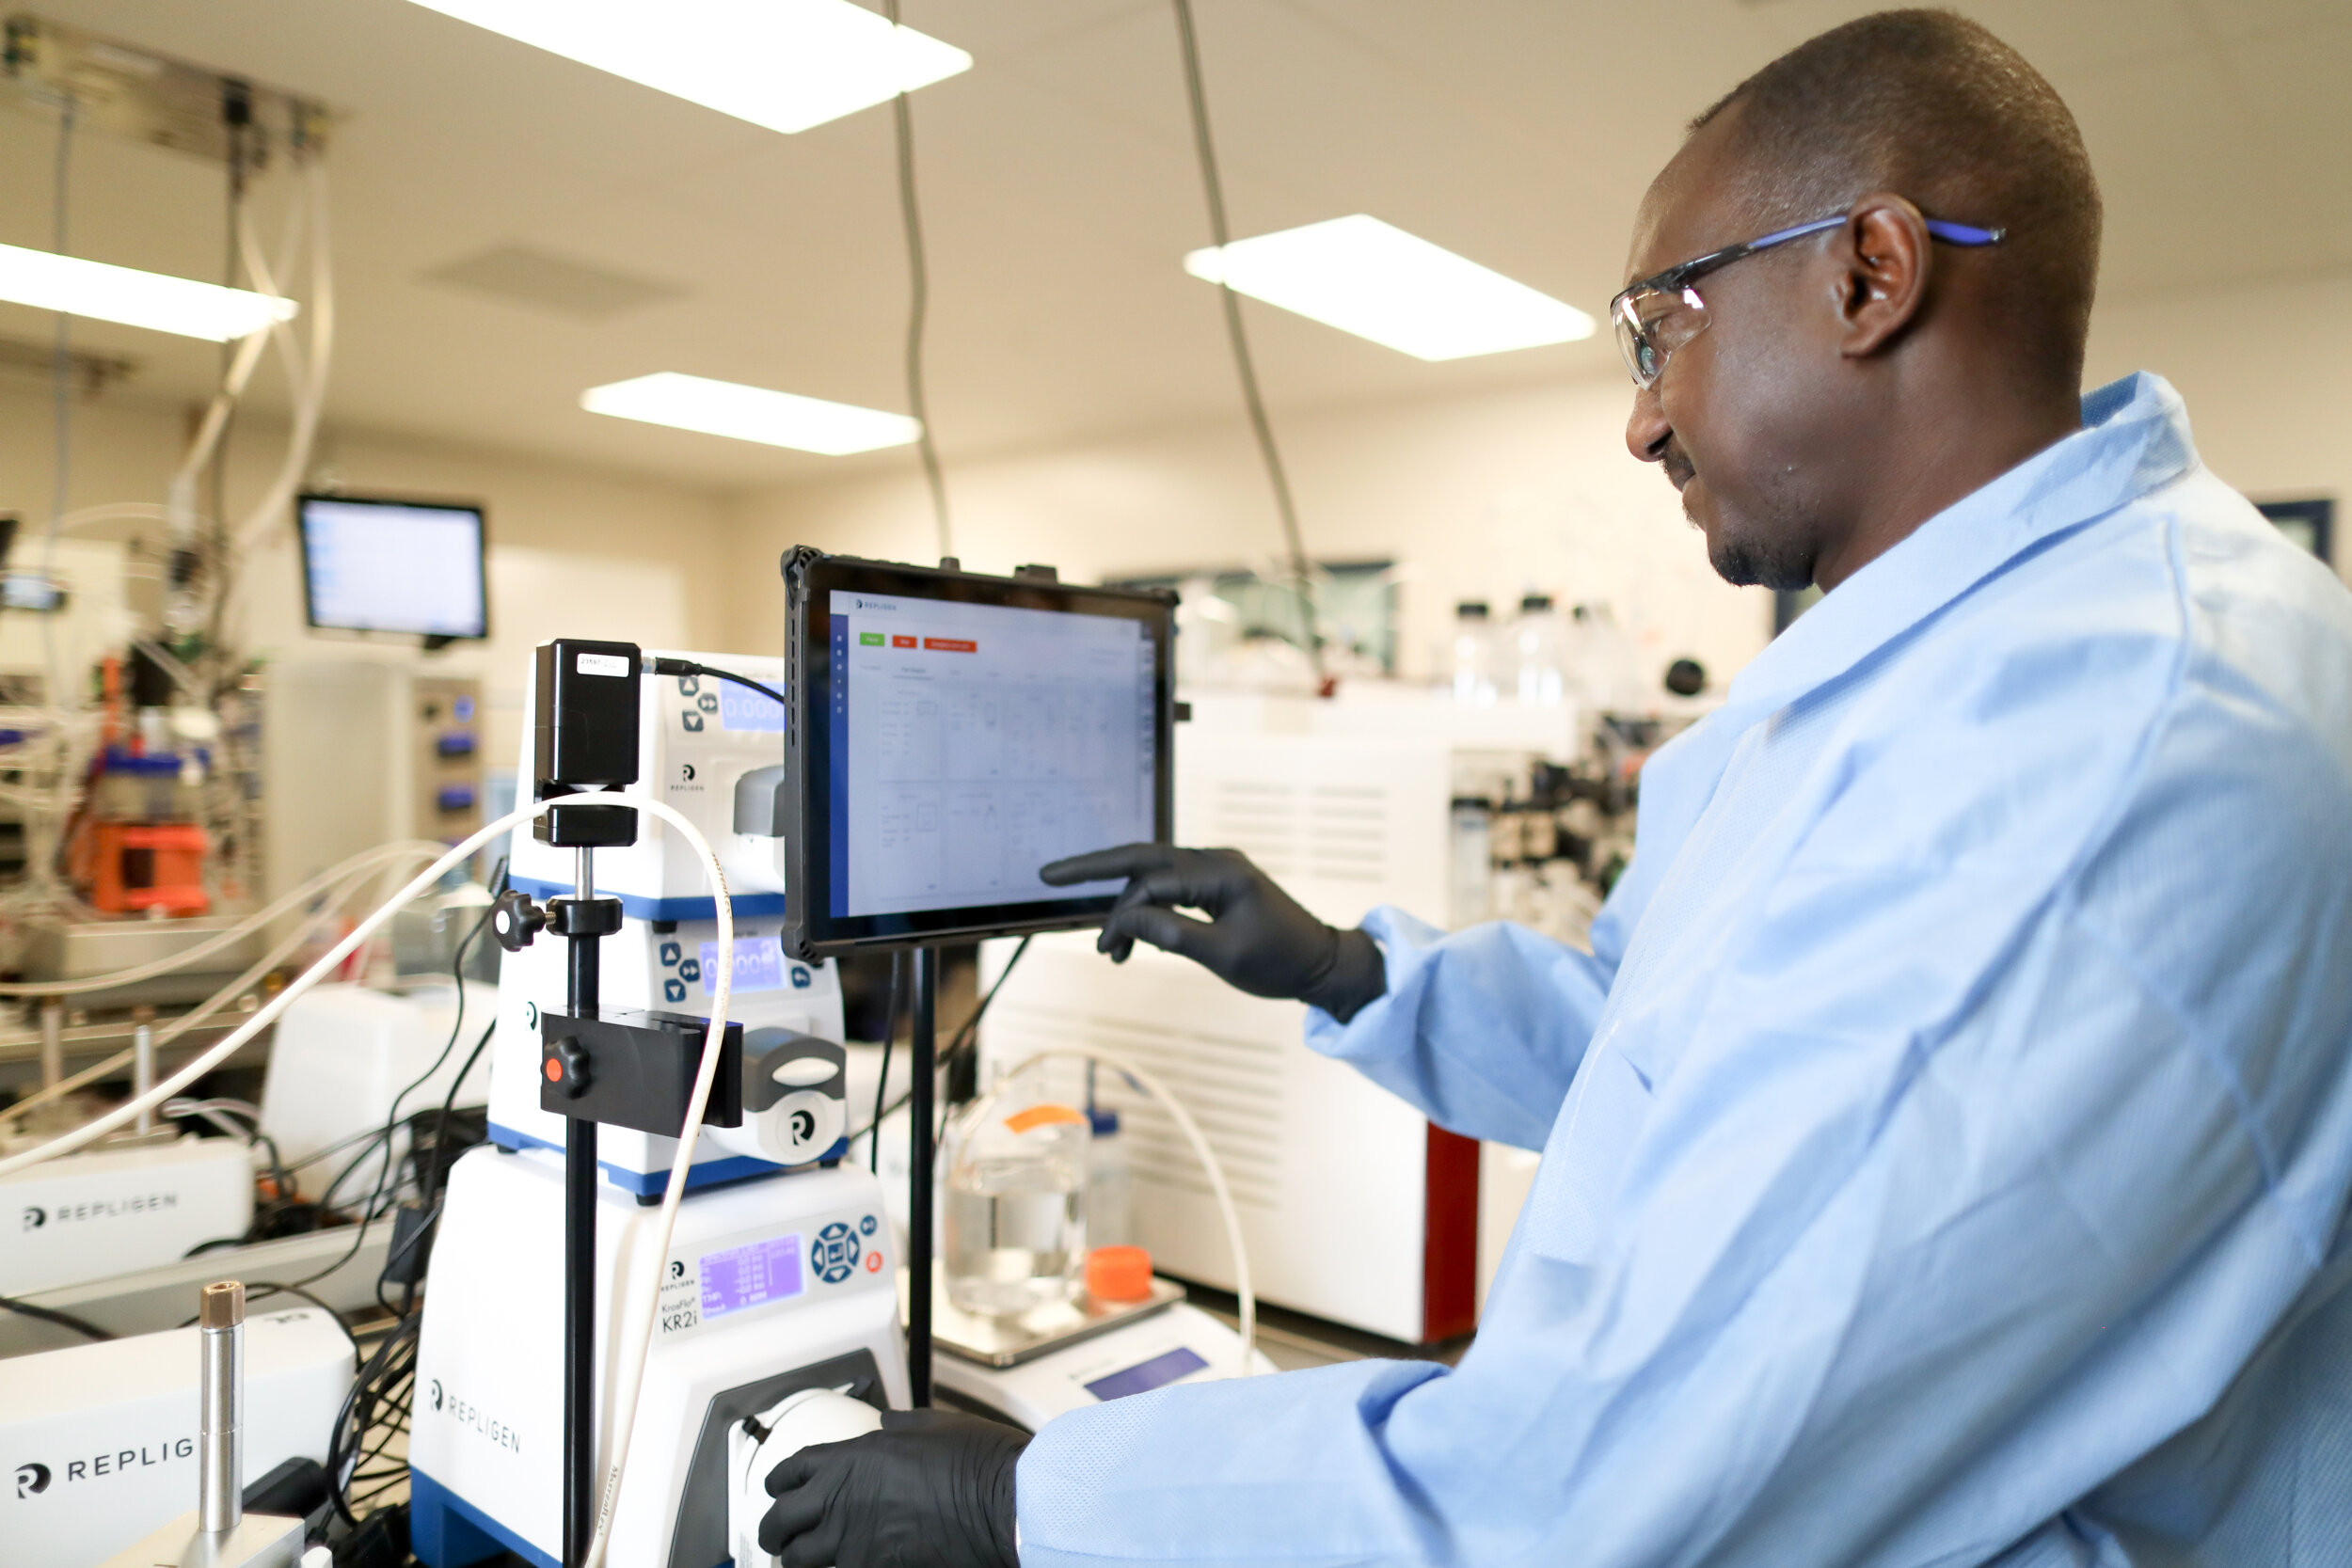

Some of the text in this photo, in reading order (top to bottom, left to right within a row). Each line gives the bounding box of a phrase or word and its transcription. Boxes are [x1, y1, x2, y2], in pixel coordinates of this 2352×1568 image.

[57, 1194, 178, 1222] REPLIGEN
[660, 1279, 695, 1292] REPLIGEN
[662, 1311, 698, 1334] KR2i
[449, 1395, 520, 1454] REPLIGEN
[68, 1438, 194, 1482] REPLIG
